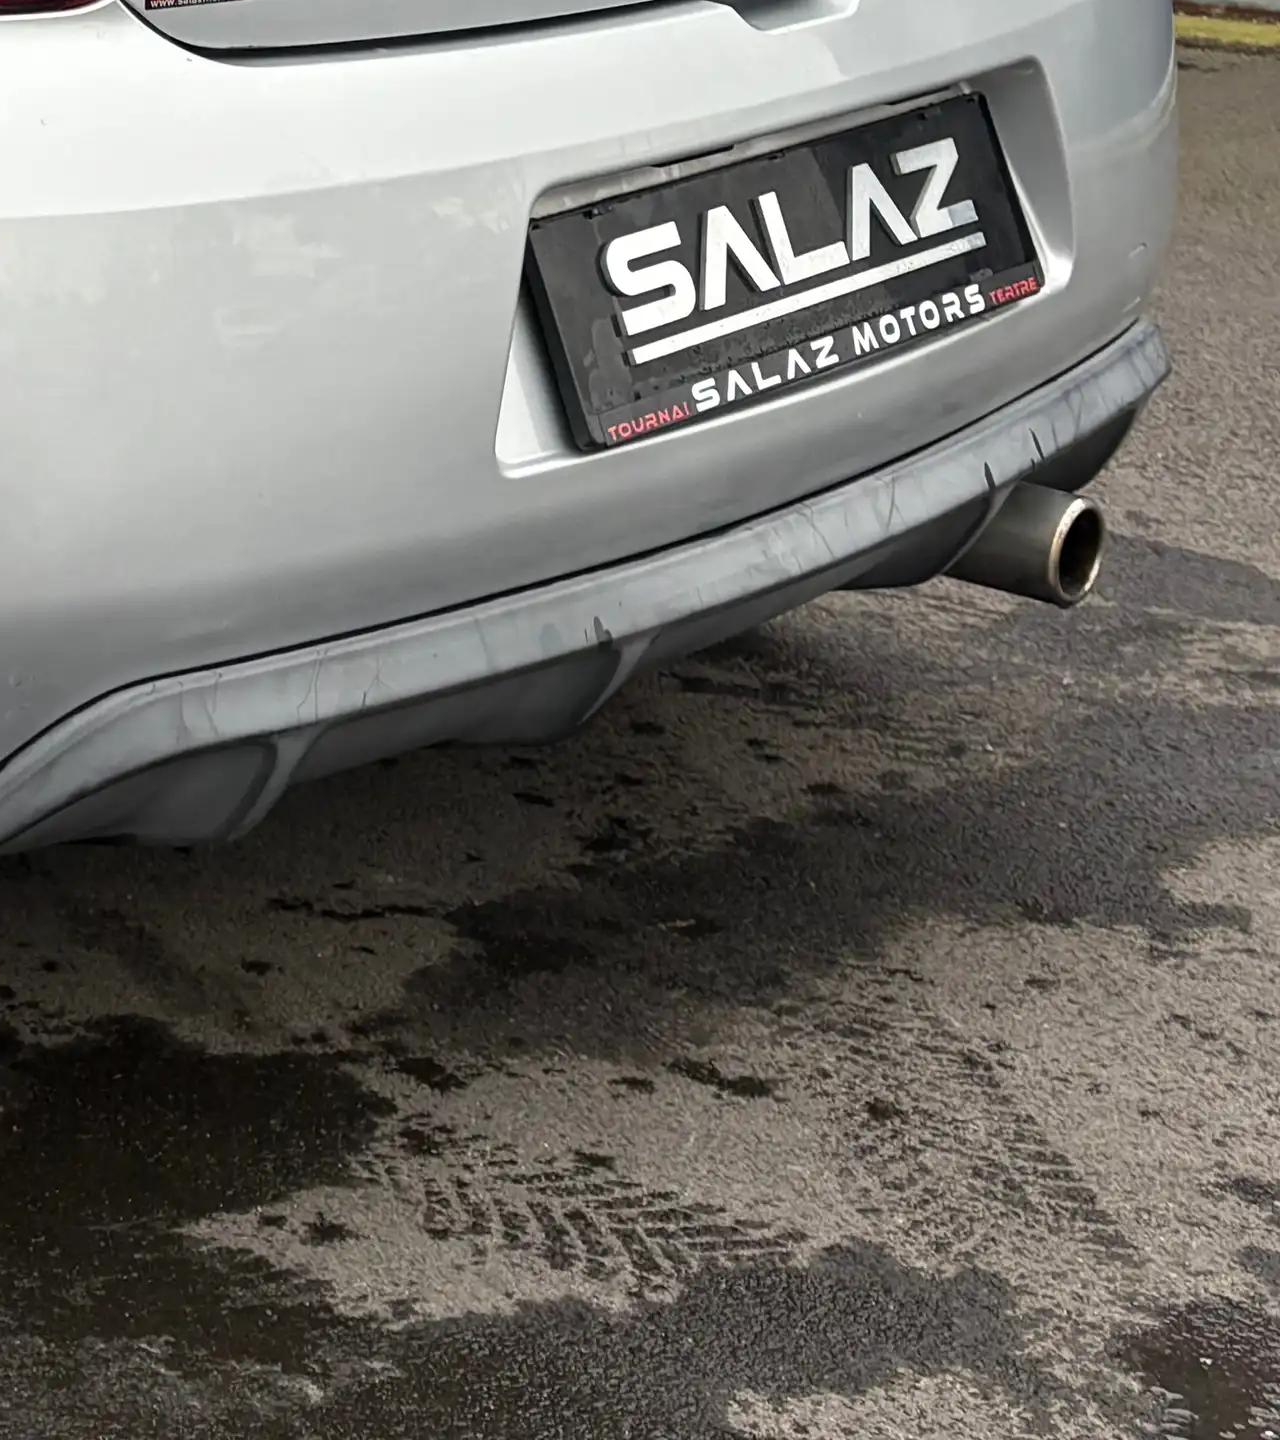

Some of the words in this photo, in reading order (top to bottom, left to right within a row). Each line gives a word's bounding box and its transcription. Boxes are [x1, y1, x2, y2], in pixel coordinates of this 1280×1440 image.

[601, 136, 980, 336] SALAZ
[607, 401, 690, 442] TOURNAI
[691, 336, 839, 412] SALAZ
[852, 284, 986, 358] MOTORS
[988, 276, 1038, 306] TERTRE
